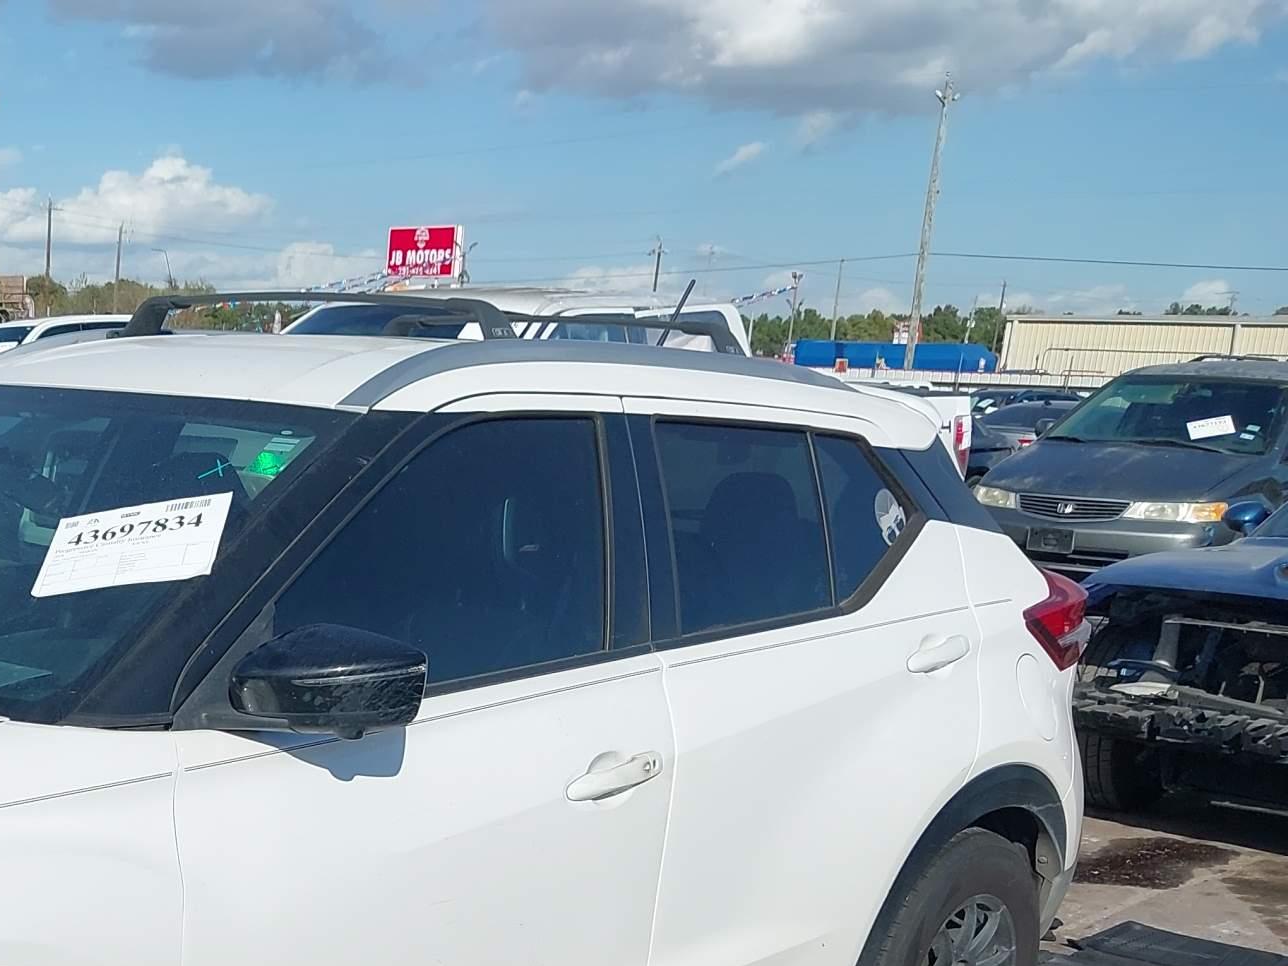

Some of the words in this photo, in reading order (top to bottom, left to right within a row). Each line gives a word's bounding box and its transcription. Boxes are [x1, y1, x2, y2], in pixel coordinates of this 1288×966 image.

[389, 249, 403, 266] JB
[405, 248, 452, 265] MOTORS
[68, 512, 204, 546] 43697834
